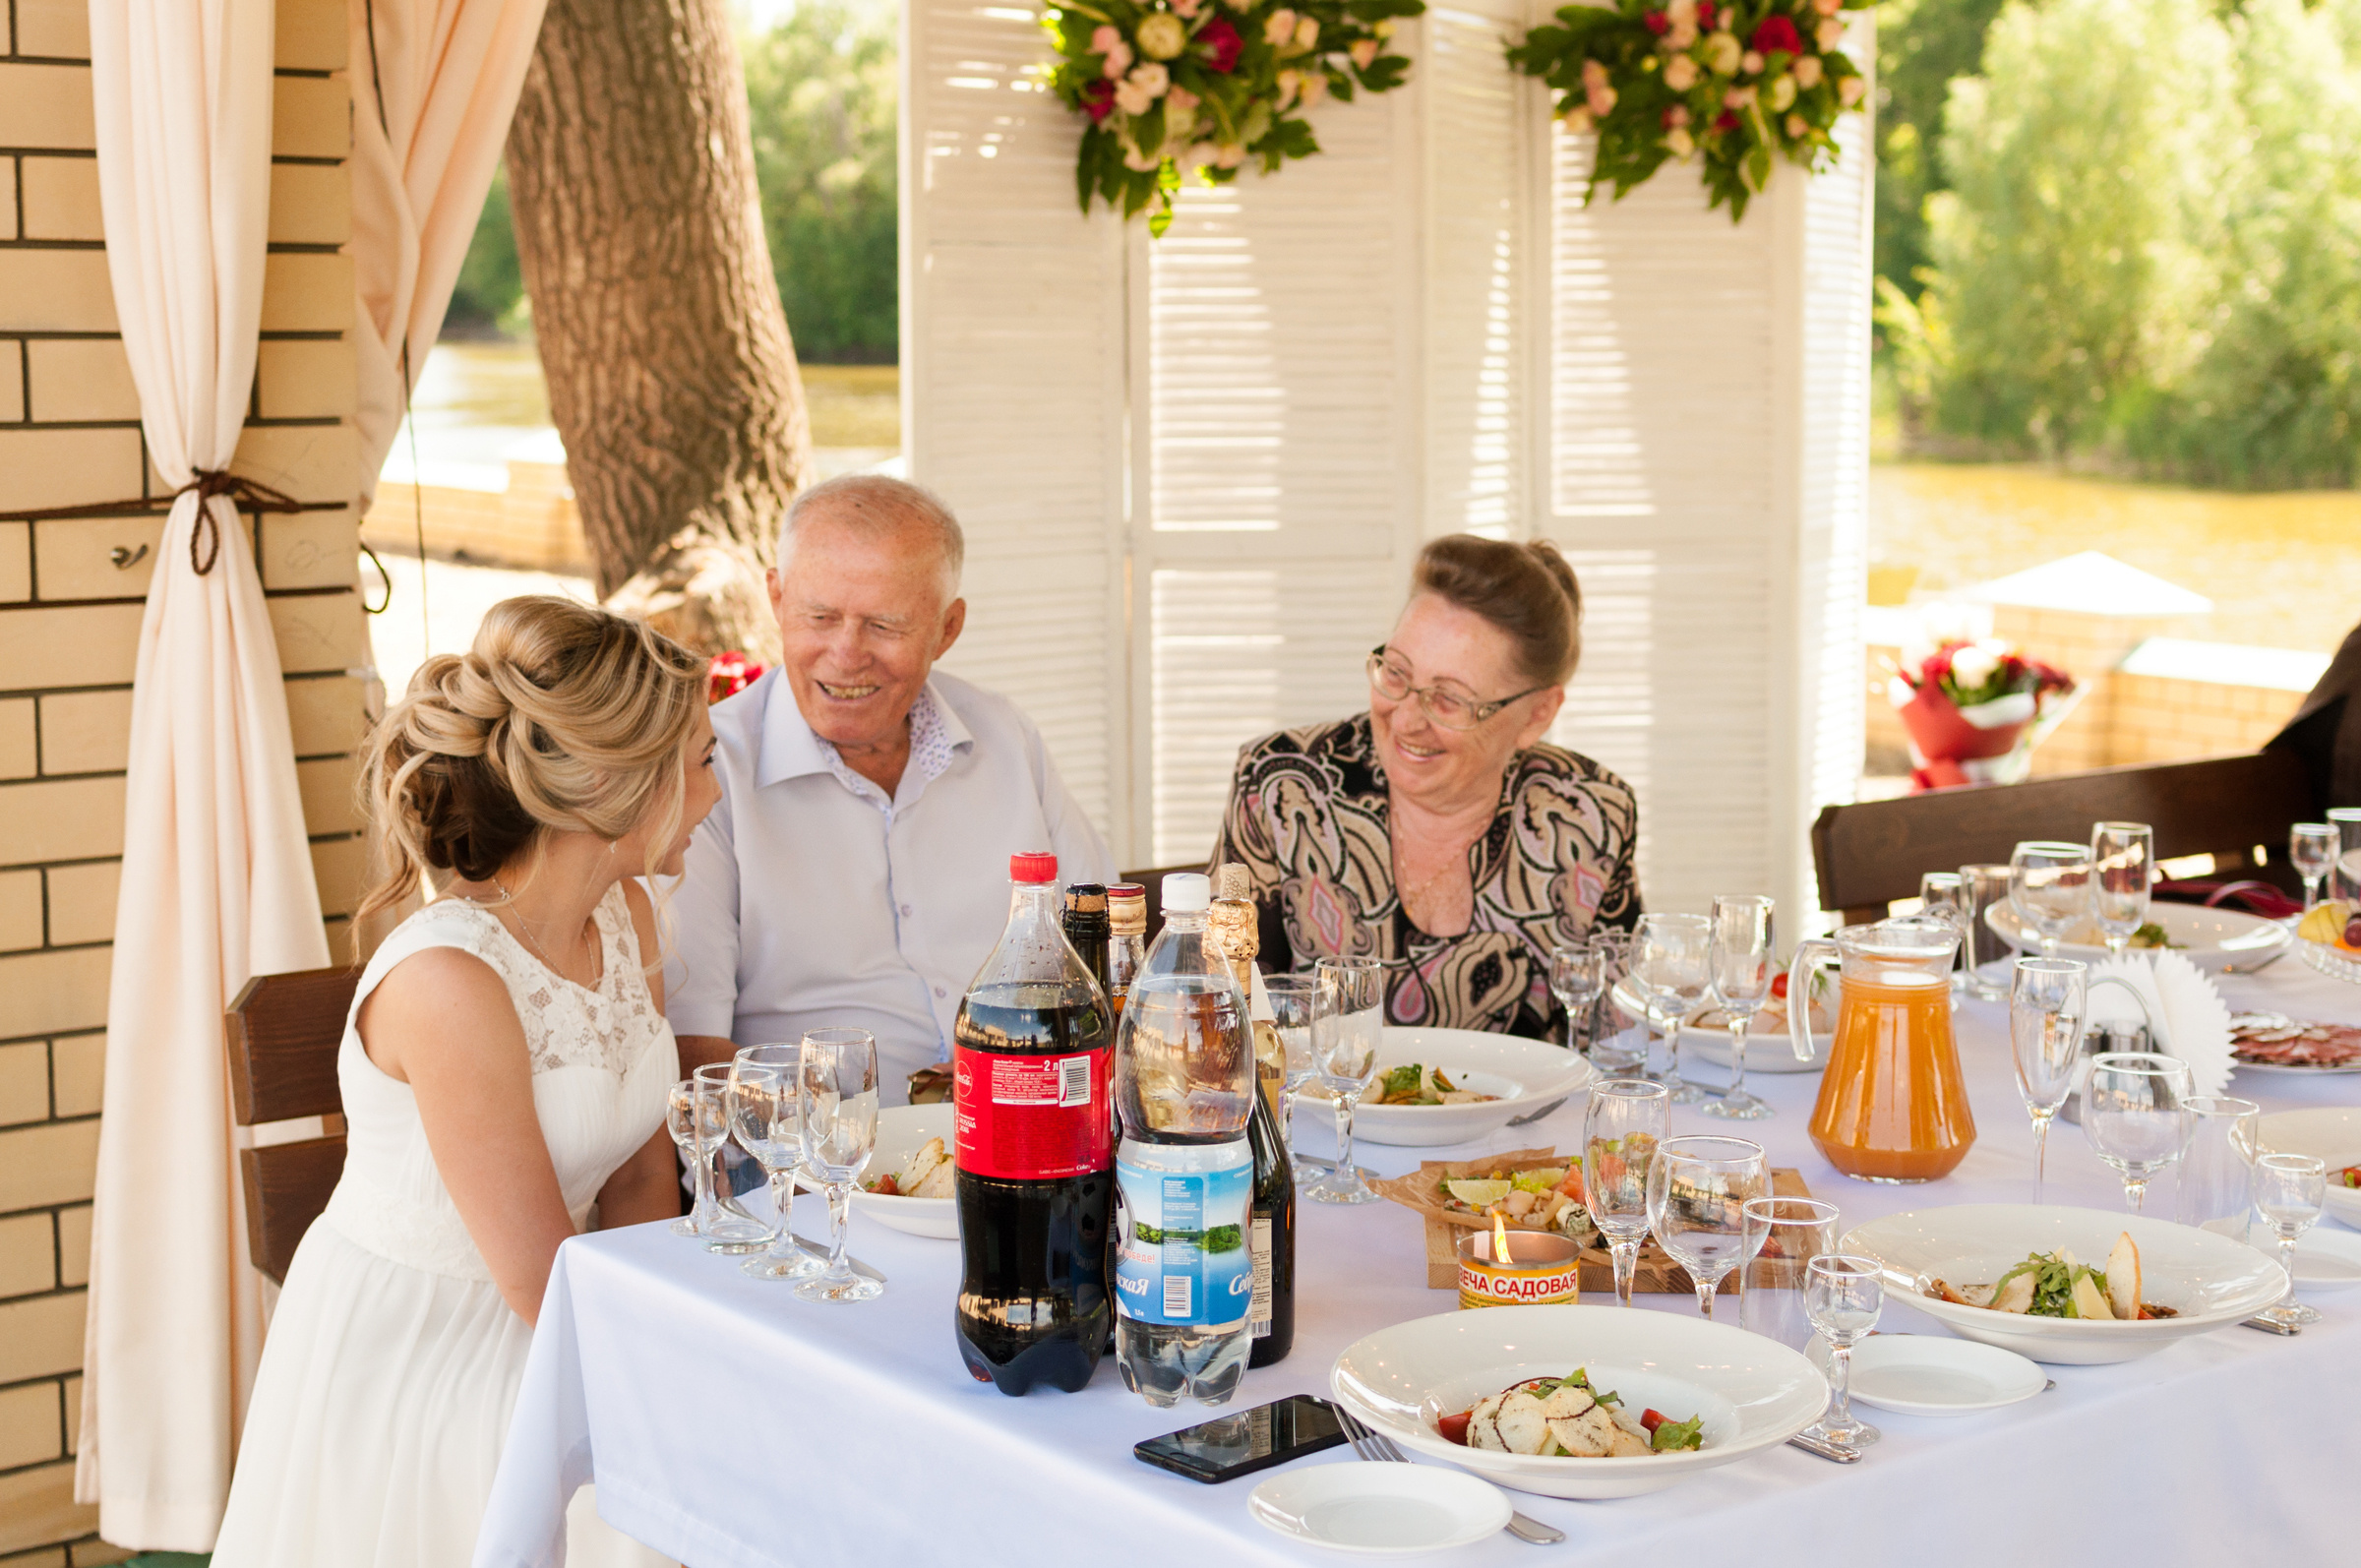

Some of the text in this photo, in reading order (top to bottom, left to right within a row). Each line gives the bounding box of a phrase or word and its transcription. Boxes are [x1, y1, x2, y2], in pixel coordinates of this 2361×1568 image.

[1044, 1059, 1051, 1071] 2
[1053, 1062, 1059, 1071] л
[1123, 1248, 1156, 1264] победе!
[1493, 1271, 1576, 1298] САДОВАЯ
